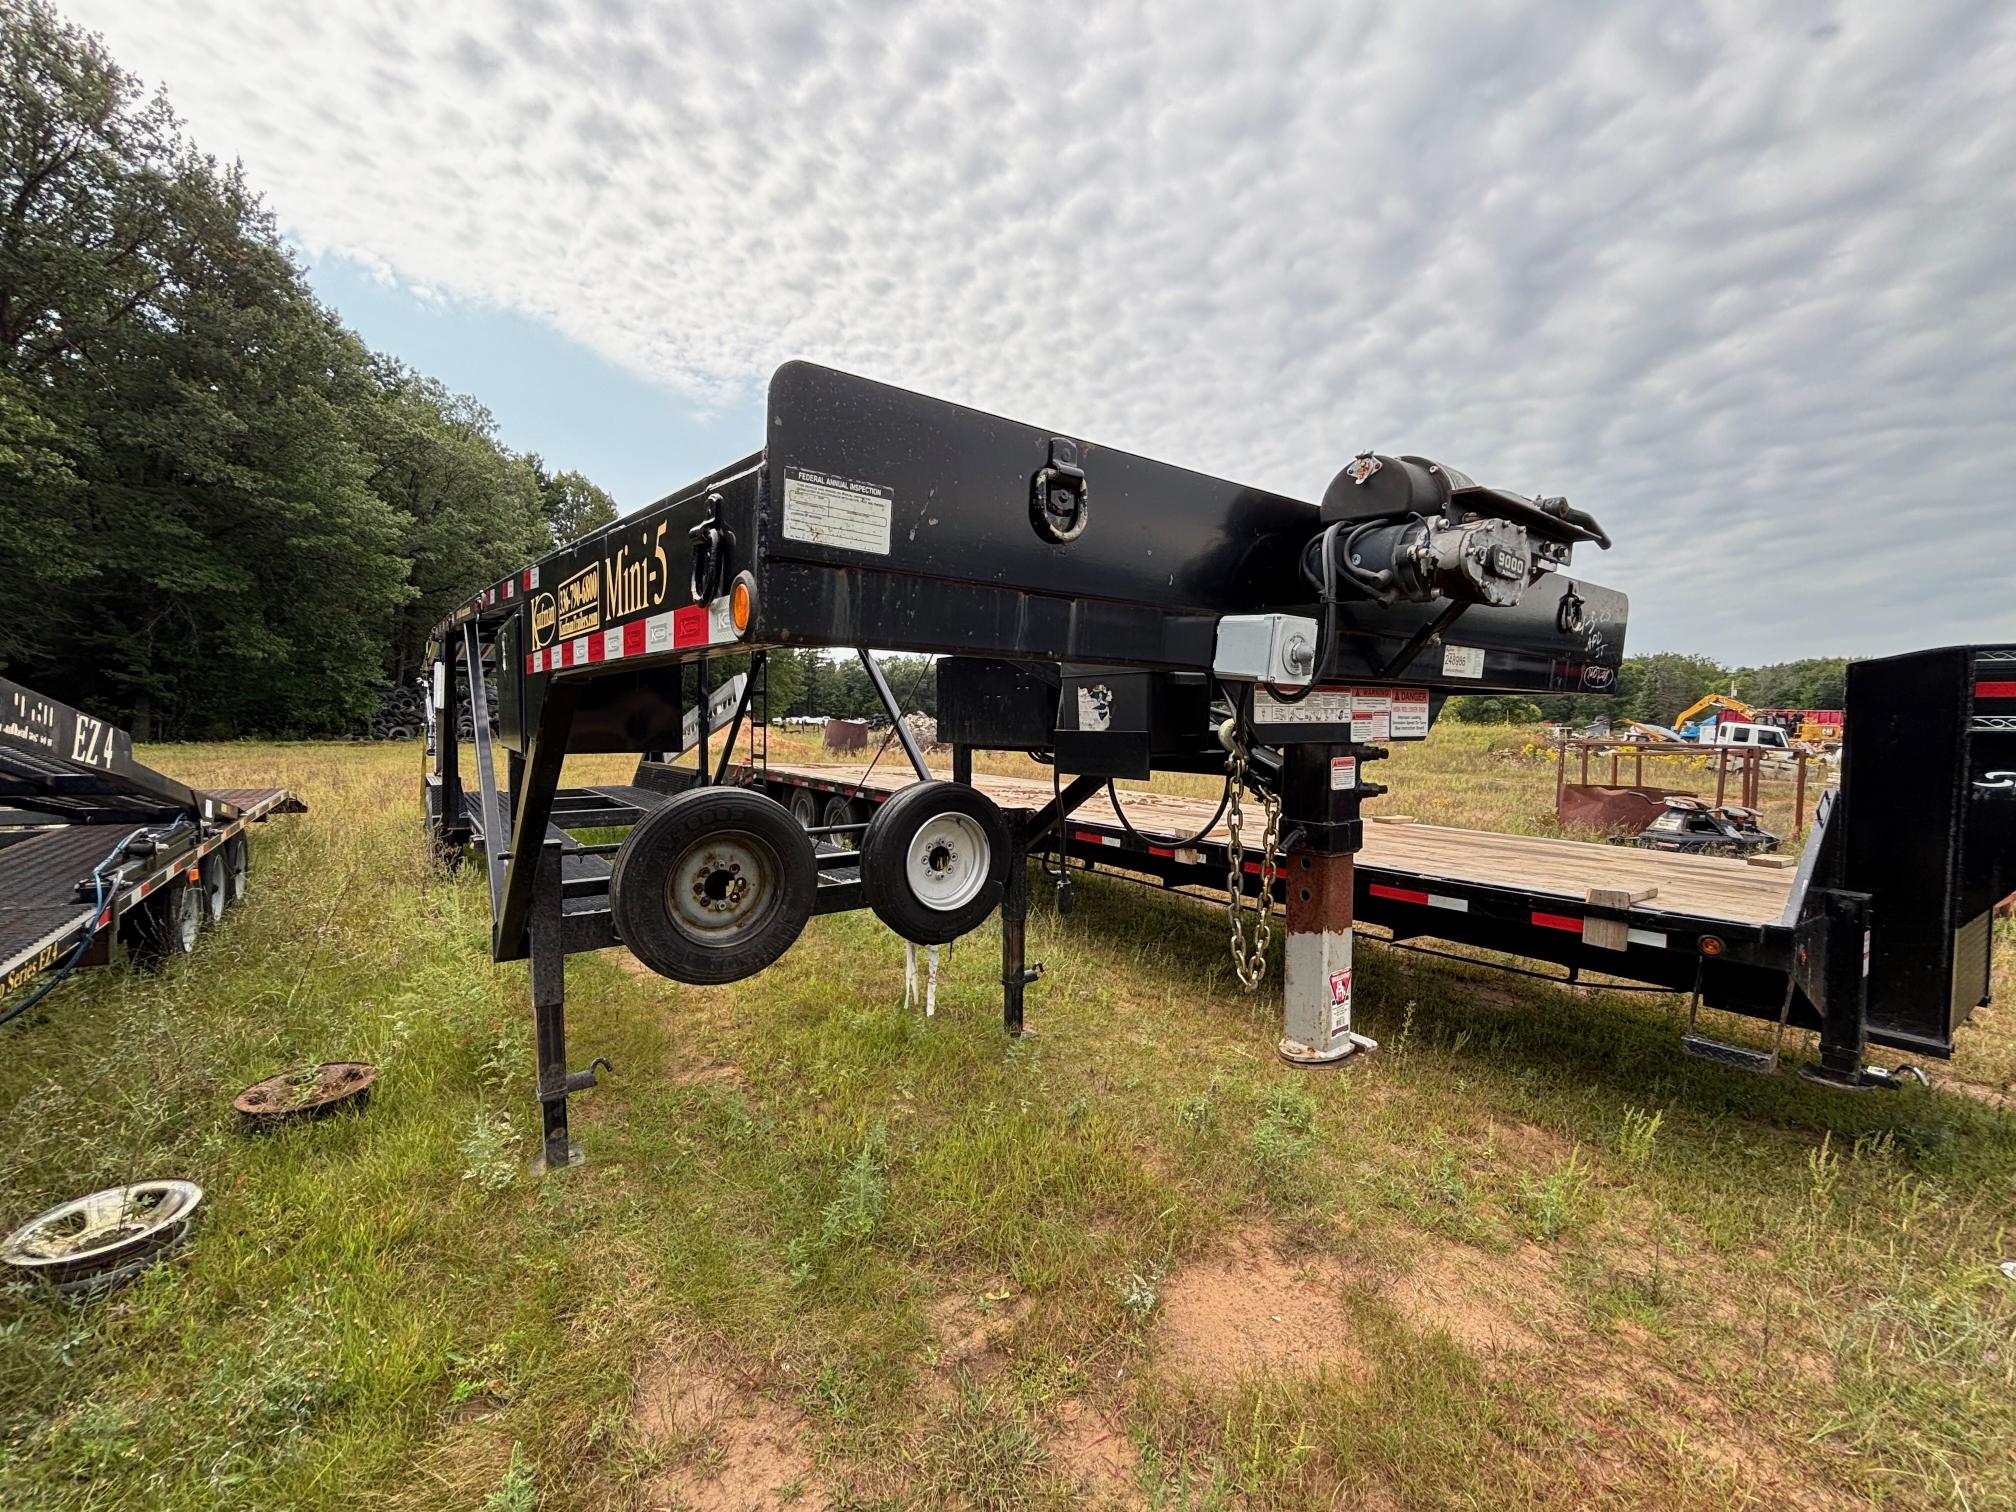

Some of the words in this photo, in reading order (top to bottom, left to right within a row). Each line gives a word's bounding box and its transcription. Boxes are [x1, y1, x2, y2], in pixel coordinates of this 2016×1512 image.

[798, 471, 825, 484] FEDERAL
[826, 478, 849, 489] ANNUAL
[849, 484, 882, 496] INSPECTION
[605, 519, 668, 621] Mini-5
[1498, 551, 1524, 574] 9000
[530, 592, 556, 652] Kaufman
[1401, 691, 1427, 701] DANGER
[7, 961, 38, 993] Series
